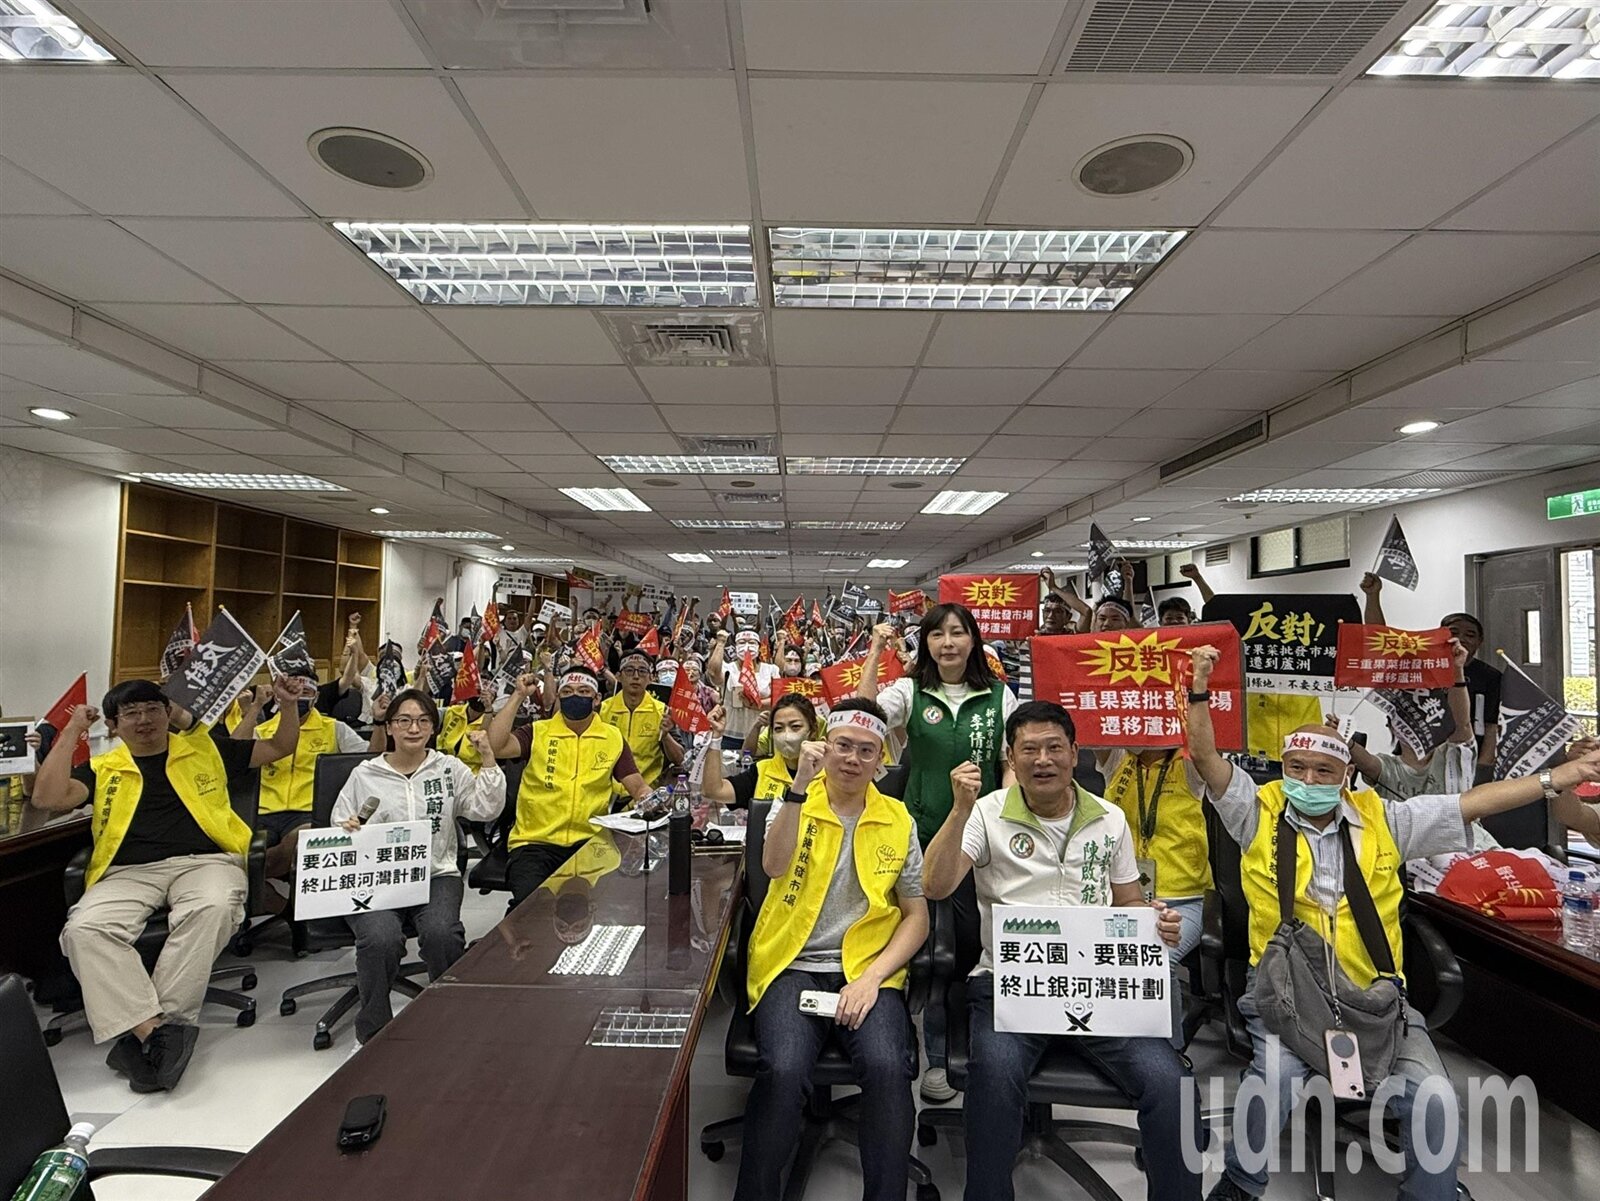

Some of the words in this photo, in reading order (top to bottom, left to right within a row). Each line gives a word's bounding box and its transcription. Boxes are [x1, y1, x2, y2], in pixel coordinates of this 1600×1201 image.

[977, 585, 1006, 600] 反對
[977, 622, 1011, 634] 移蘆洲
[1241, 601, 1326, 646] 反對!
[1382, 634, 1418, 650] 反對
[1110, 644, 1168, 672] 反對
[1346, 657, 1450, 670] 三重果菜批發市場
[1371, 672, 1423, 684] 遷移蘆洲
[1059, 689, 1233, 712] 三重果菜批發場
[1100, 715, 1182, 737] 遷移蘆洲
[302, 844, 428, 871] 要公園、要醫院
[782, 822, 818, 908] 拒絕批發市場
[301, 866, 427, 895] 終止銀河灣計劃
[1000, 941, 1164, 968] 要公園、要醫院
[1000, 974, 1165, 1001] 終止銀河灣計劃
